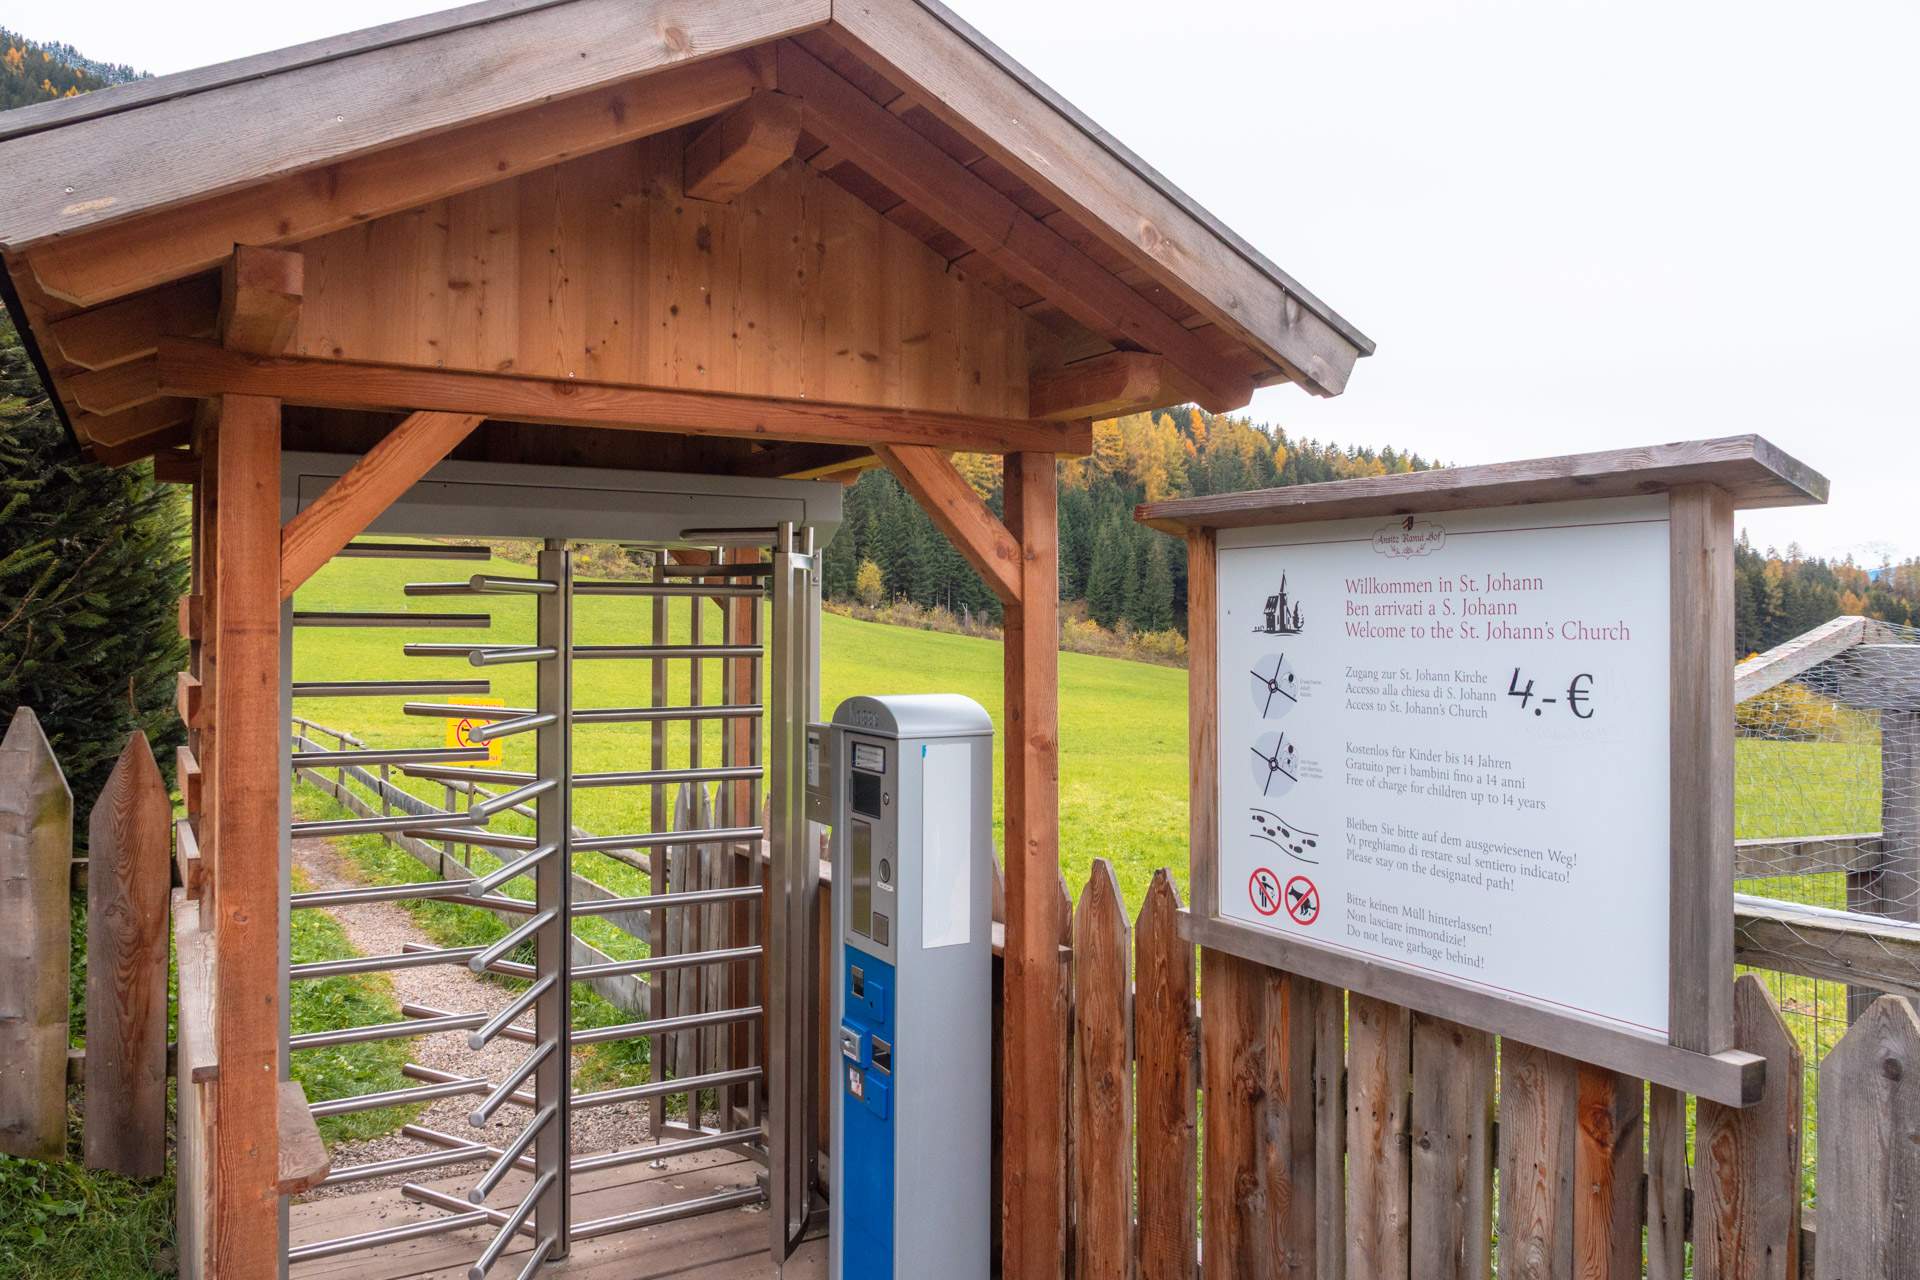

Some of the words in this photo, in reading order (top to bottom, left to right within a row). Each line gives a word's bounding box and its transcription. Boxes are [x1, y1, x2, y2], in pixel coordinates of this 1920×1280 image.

[1345, 576, 1432, 595] Willkommen
[1439, 576, 1452, 593] in
[1459, 574, 1478, 593] St.
[1487, 572, 1542, 593] Johann
[1346, 600, 1369, 617] Ben
[1374, 599, 1422, 616] arrivati
[1428, 604, 1435, 616] a
[1442, 598, 1455, 616] S.
[1463, 597, 1517, 618] Johann
[1345, 620, 1405, 639] Welcome
[1411, 625, 1425, 639] to
[1430, 620, 1456, 639] the
[1459, 621, 1479, 640] St.
[1487, 620, 1554, 641] Johann's
[1561, 621, 1629, 641] Church
[1345, 665, 1378, 683] Zugang
[1381, 671, 1397, 681] zur
[1399, 667, 1411, 681] St.
[1416, 667, 1450, 683] Johann
[1454, 669, 1487, 684] Kirche
[1345, 680, 1380, 697] Accesso
[1381, 682, 1398, 696] alla
[1400, 684, 1430, 699] chiesa
[1433, 685, 1442, 700] di
[1446, 686, 1455, 700] S.
[1460, 686, 1496, 702] Johann
[1345, 696, 1375, 713] Access
[1375, 702, 1387, 713] to
[1389, 699, 1401, 713] St.
[1405, 700, 1445, 720] Johann's
[1448, 702, 1487, 719] Church
[1566, 673, 1595, 719] €
[1345, 741, 1389, 759] Kostenlos
[1391, 745, 1406, 760] für
[1408, 747, 1442, 763] Kinder
[1445, 750, 1459, 765] bis
[1463, 753, 1473, 767] 14
[1477, 752, 1511, 770] Jahren
[1345, 756, 1383, 773] Gratuito
[1385, 759, 1401, 778] per
[1403, 764, 1406, 776] i
[1410, 762, 1449, 781] bambini
[1453, 768, 1473, 784] fino
[1476, 775, 1482, 785] a
[1486, 773, 1497, 787] 14
[1500, 776, 1525, 790] anni
[1346, 772, 1364, 787] Free
[1365, 774, 1375, 788] of
[1377, 775, 1407, 795] charge
[1410, 780, 1424, 794] for
[1426, 782, 1466, 801] children
[1470, 792, 1486, 806] up
[1487, 792, 1501, 804] to
[1503, 790, 1513, 806] 14
[1517, 797, 1545, 811] years
[1345, 815, 1377, 833] Bleiben
[1380, 822, 1394, 836] Sie
[1397, 823, 1418, 840] bitte
[1421, 830, 1437, 845] auf
[1440, 832, 1461, 847] dem
[1465, 839, 1543, 865] ausgewiesenen
[1548, 848, 1576, 870] Weg!
[1346, 830, 1356, 846] Vi
[1358, 837, 1405, 854] preghiamo
[1408, 843, 1418, 857] di
[1420, 846, 1453, 864] restare
[1456, 852, 1472, 867] sul
[1474, 855, 1516, 874] sentiero
[1519, 861, 1570, 884] indicato!
[1346, 847, 1373, 865] Please
[1375, 850, 1394, 872] stay
[1396, 860, 1408, 872] on
[1411, 860, 1426, 875] the
[1428, 861, 1482, 886] designated
[1486, 871, 1513, 892] path!
[1346, 891, 1366, 908] Bitte
[1369, 896, 1398, 915] keinen
[1401, 905, 1424, 921] Müll
[1428, 910, 1491, 936] hinterlassen!
[1346, 907, 1366, 924] Non
[1369, 911, 1402, 933] lasciare
[1405, 922, 1465, 948] immondizie!
[1346, 923, 1360, 938] Do
[1363, 927, 1378, 944] not
[1381, 931, 1404, 951] leave
[1406, 935, 1443, 962] garbage
[1445, 946, 1483, 970] behind!
